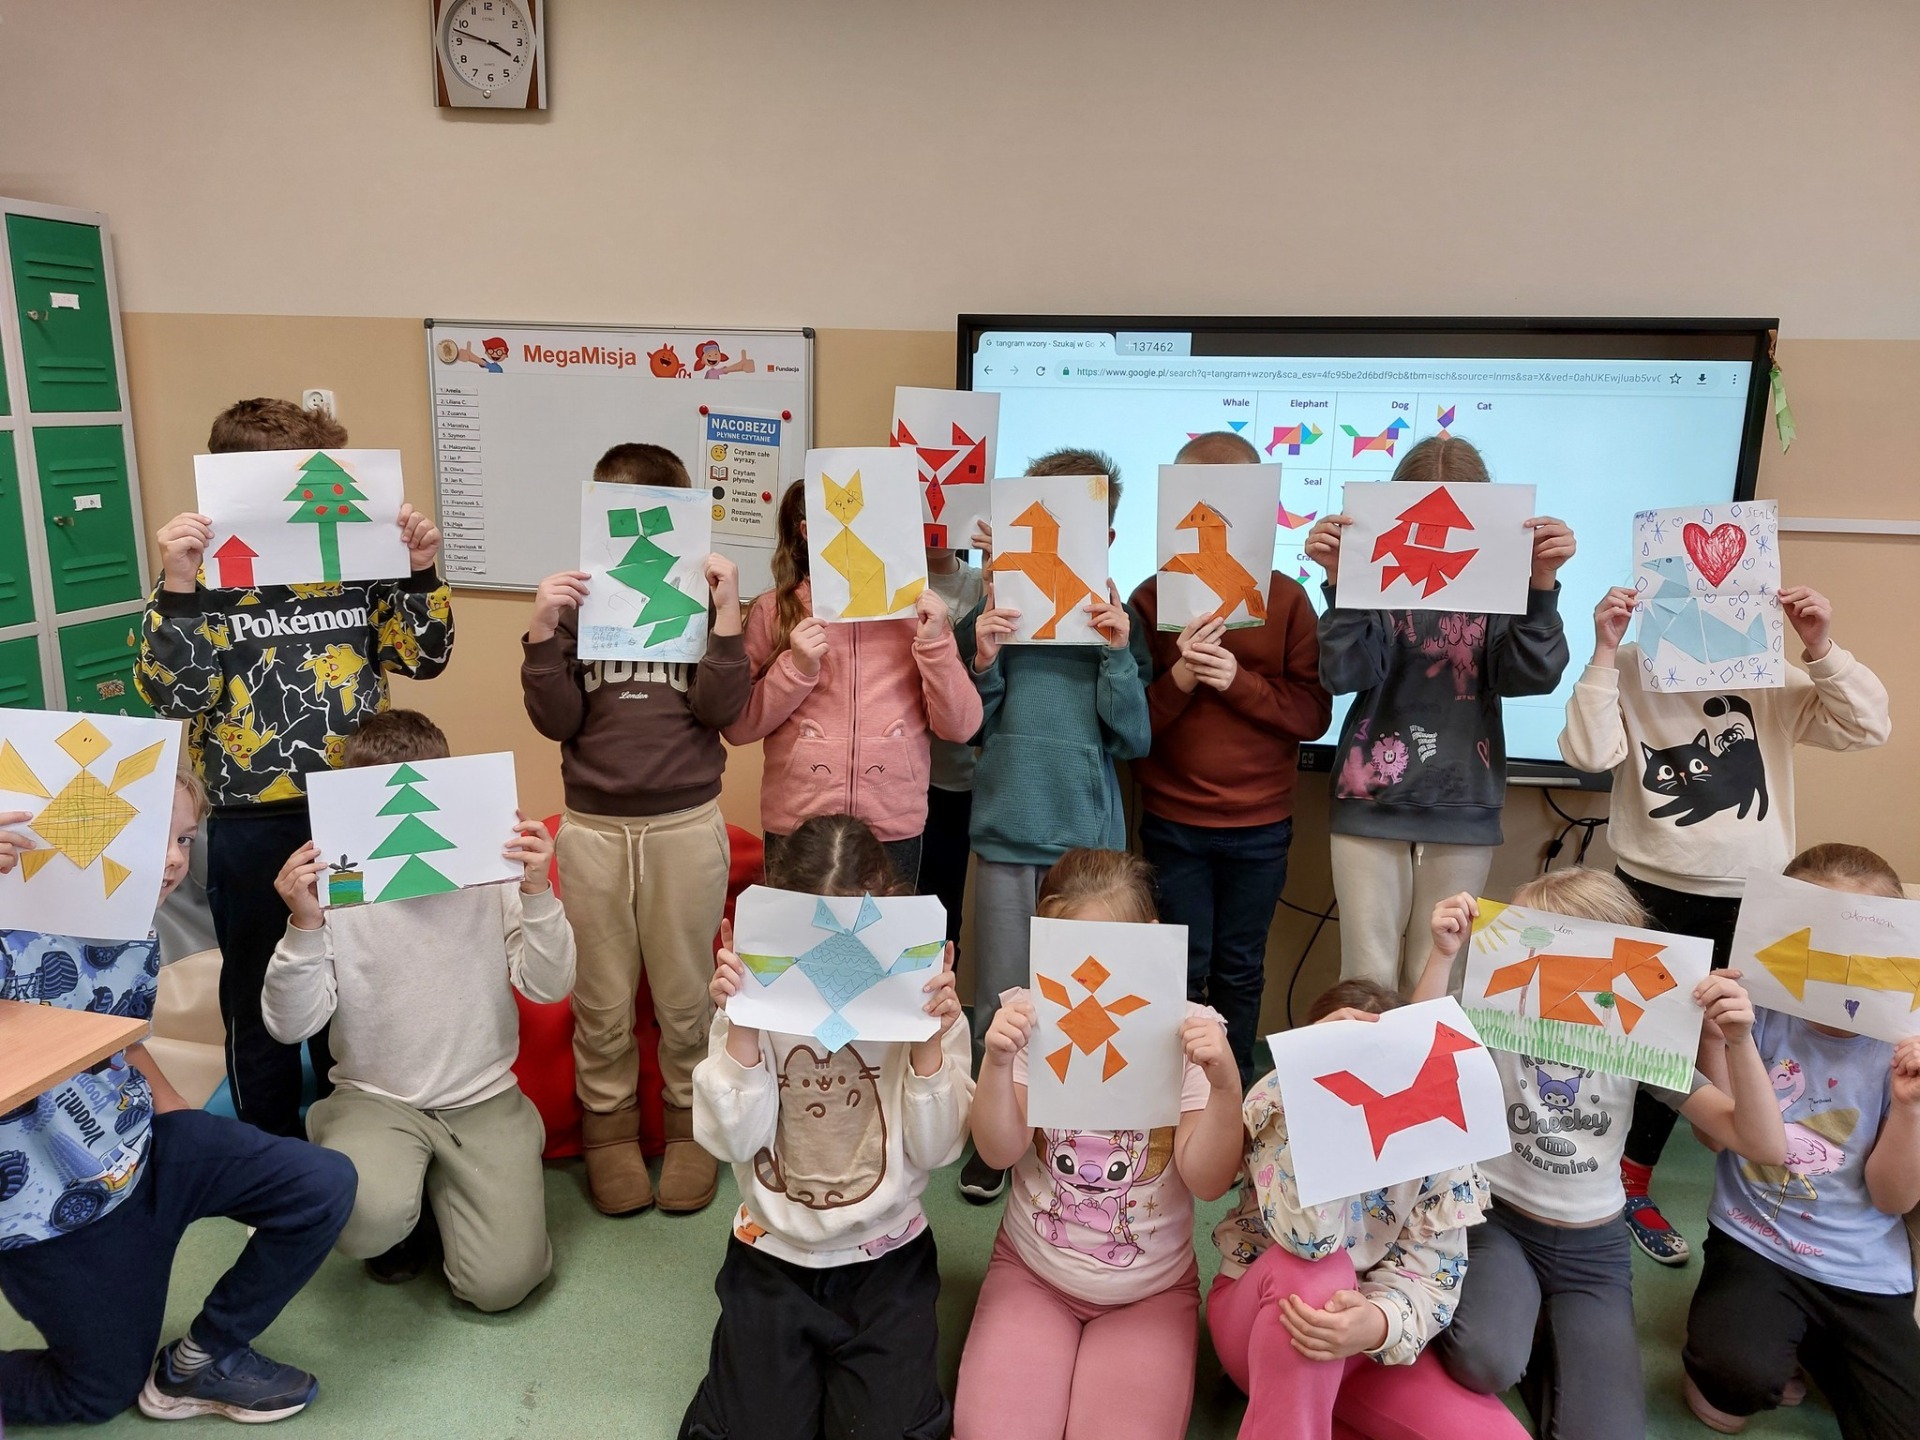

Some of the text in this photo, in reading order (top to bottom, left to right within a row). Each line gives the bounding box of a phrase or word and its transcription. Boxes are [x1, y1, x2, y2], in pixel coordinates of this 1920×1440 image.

[471, 7, 476, 15] 11
[484, 2, 493, 11] 12
[502, 7, 505, 15] 1
[459, 20, 469, 28] 10
[512, 21, 518, 29] 2
[456, 38, 463, 46] 9
[517, 38, 523, 47] 3
[460, 55, 468, 63] 8
[513, 55, 520, 63] 4
[472, 69, 479, 77] 7
[503, 69, 510, 78] 5
[487, 74, 494, 82] 6
[996, 340, 1025, 348] tangram
[1026, 341, 1047, 349] wzory
[1053, 340, 1076, 349] Szukaj
[1133, 342, 1173, 352] 137462
[523, 345, 636, 369] MegaMisja
[1223, 398, 1250, 407] Whale
[1290, 399, 1328, 409] Elephant
[1391, 401, 1409, 411] Dog
[1477, 402, 1492, 410] Cat
[711, 418, 776, 434] NACOBEZU
[716, 431, 771, 442] PŁYNNE CZYTANIE
[734, 448, 757, 457] Czytam
[733, 469, 755, 477] Czytam
[1304, 477, 1322, 486] Seal
[732, 489, 757, 497] Uważam
[731, 509, 763, 518] Rozumiem,
[228, 605, 367, 642] Pokémon
[618, 691, 649, 699] London
[1554, 923, 1574, 935] Lion
[1507, 1103, 1612, 1136] Cheeky
[1544, 1137, 1570, 1153] but
[1515, 1142, 1599, 1175] charming
